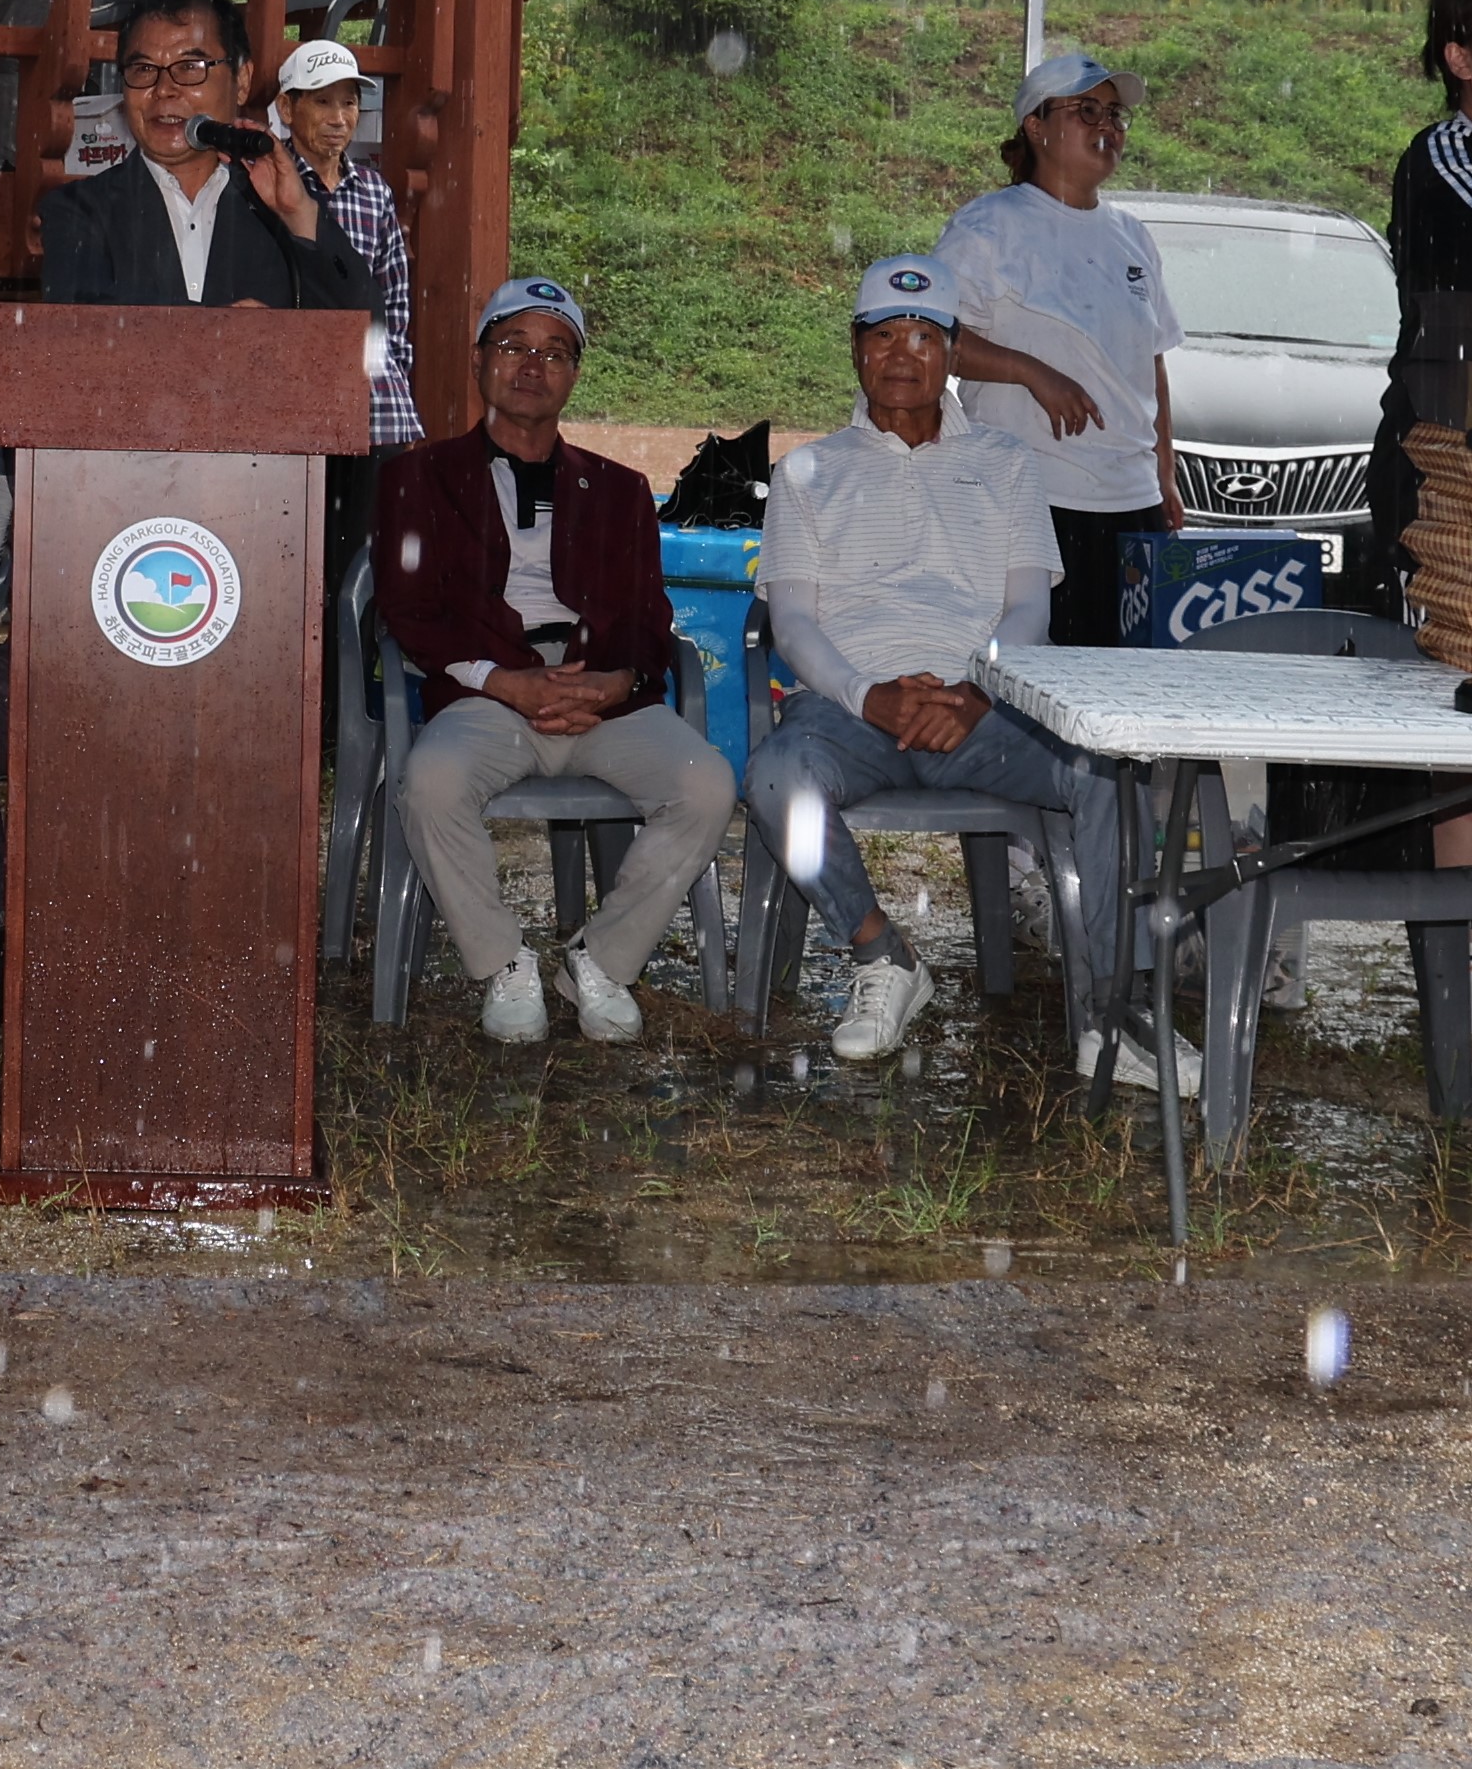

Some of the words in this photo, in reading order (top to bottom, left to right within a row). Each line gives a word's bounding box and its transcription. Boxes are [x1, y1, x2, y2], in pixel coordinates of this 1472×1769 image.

[78, 143, 129, 167] 파프리카
[98, 545, 123, 601] HADONG
[122, 523, 189, 547] PARKGOLF
[190, 531, 235, 605] ASSOCIATION
[104, 615, 229, 662] 하동군파크골프협회
